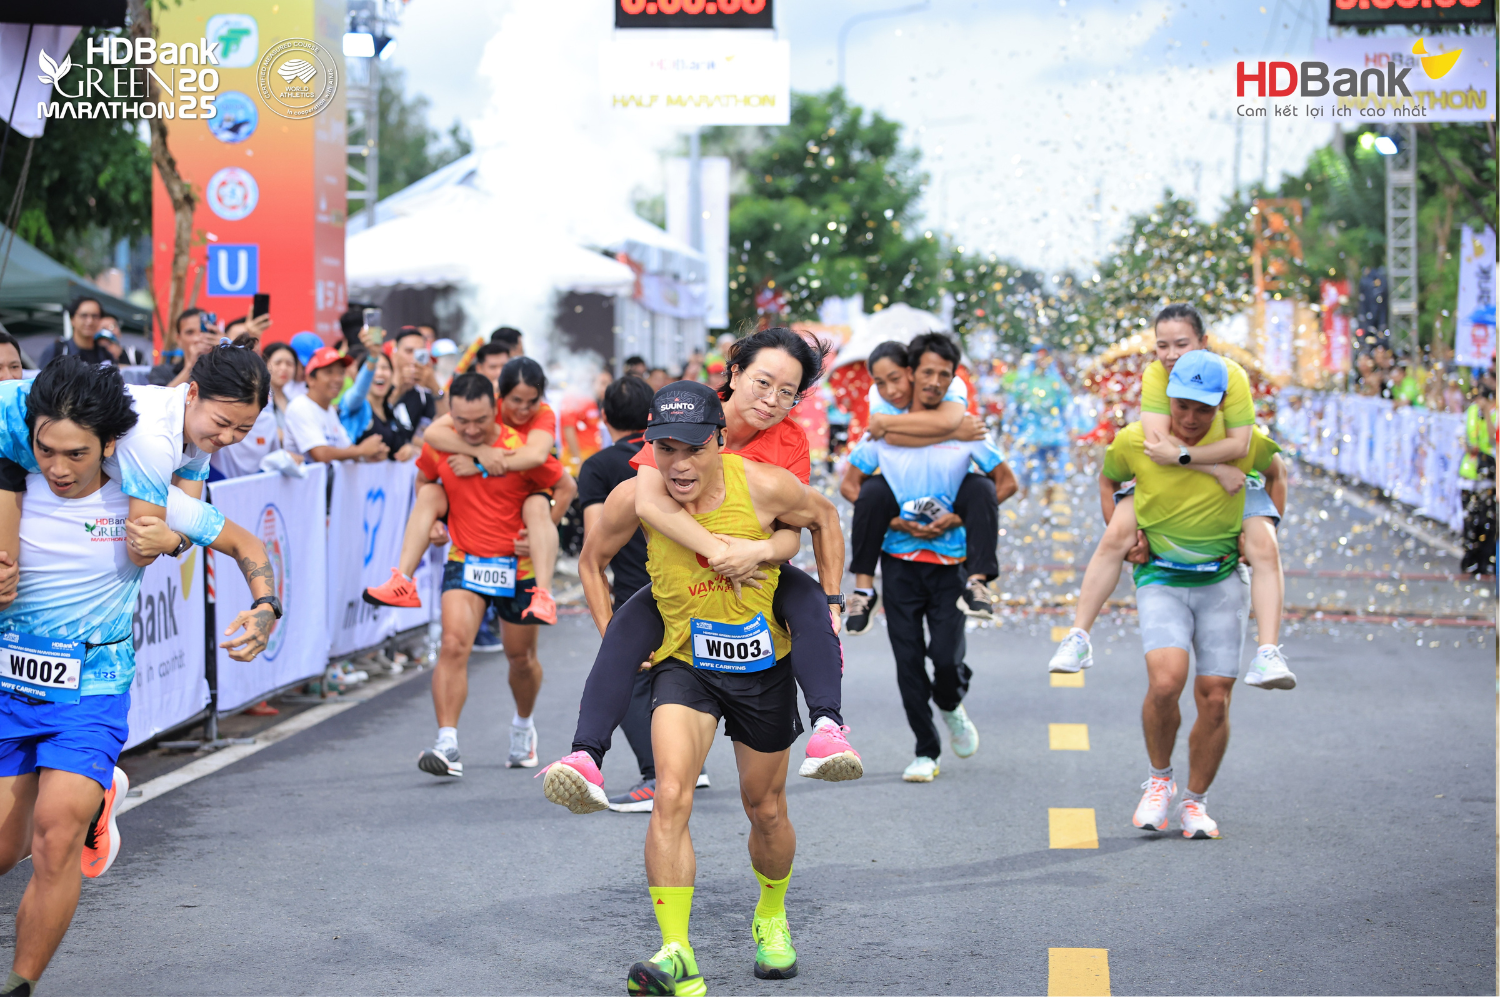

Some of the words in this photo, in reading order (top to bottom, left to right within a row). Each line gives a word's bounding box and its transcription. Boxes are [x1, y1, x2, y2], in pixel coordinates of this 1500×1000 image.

[613, 95, 658, 107] HALF
[666, 94, 776, 107] MARATHON
[660, 401, 694, 411] SUUNTO
[473, 569, 507, 584] W005
[706, 639, 762, 659] W003
[10, 654, 67, 684] W002
[1, 681, 16, 690] WIFE
[16, 685, 46, 697] CARRYING
